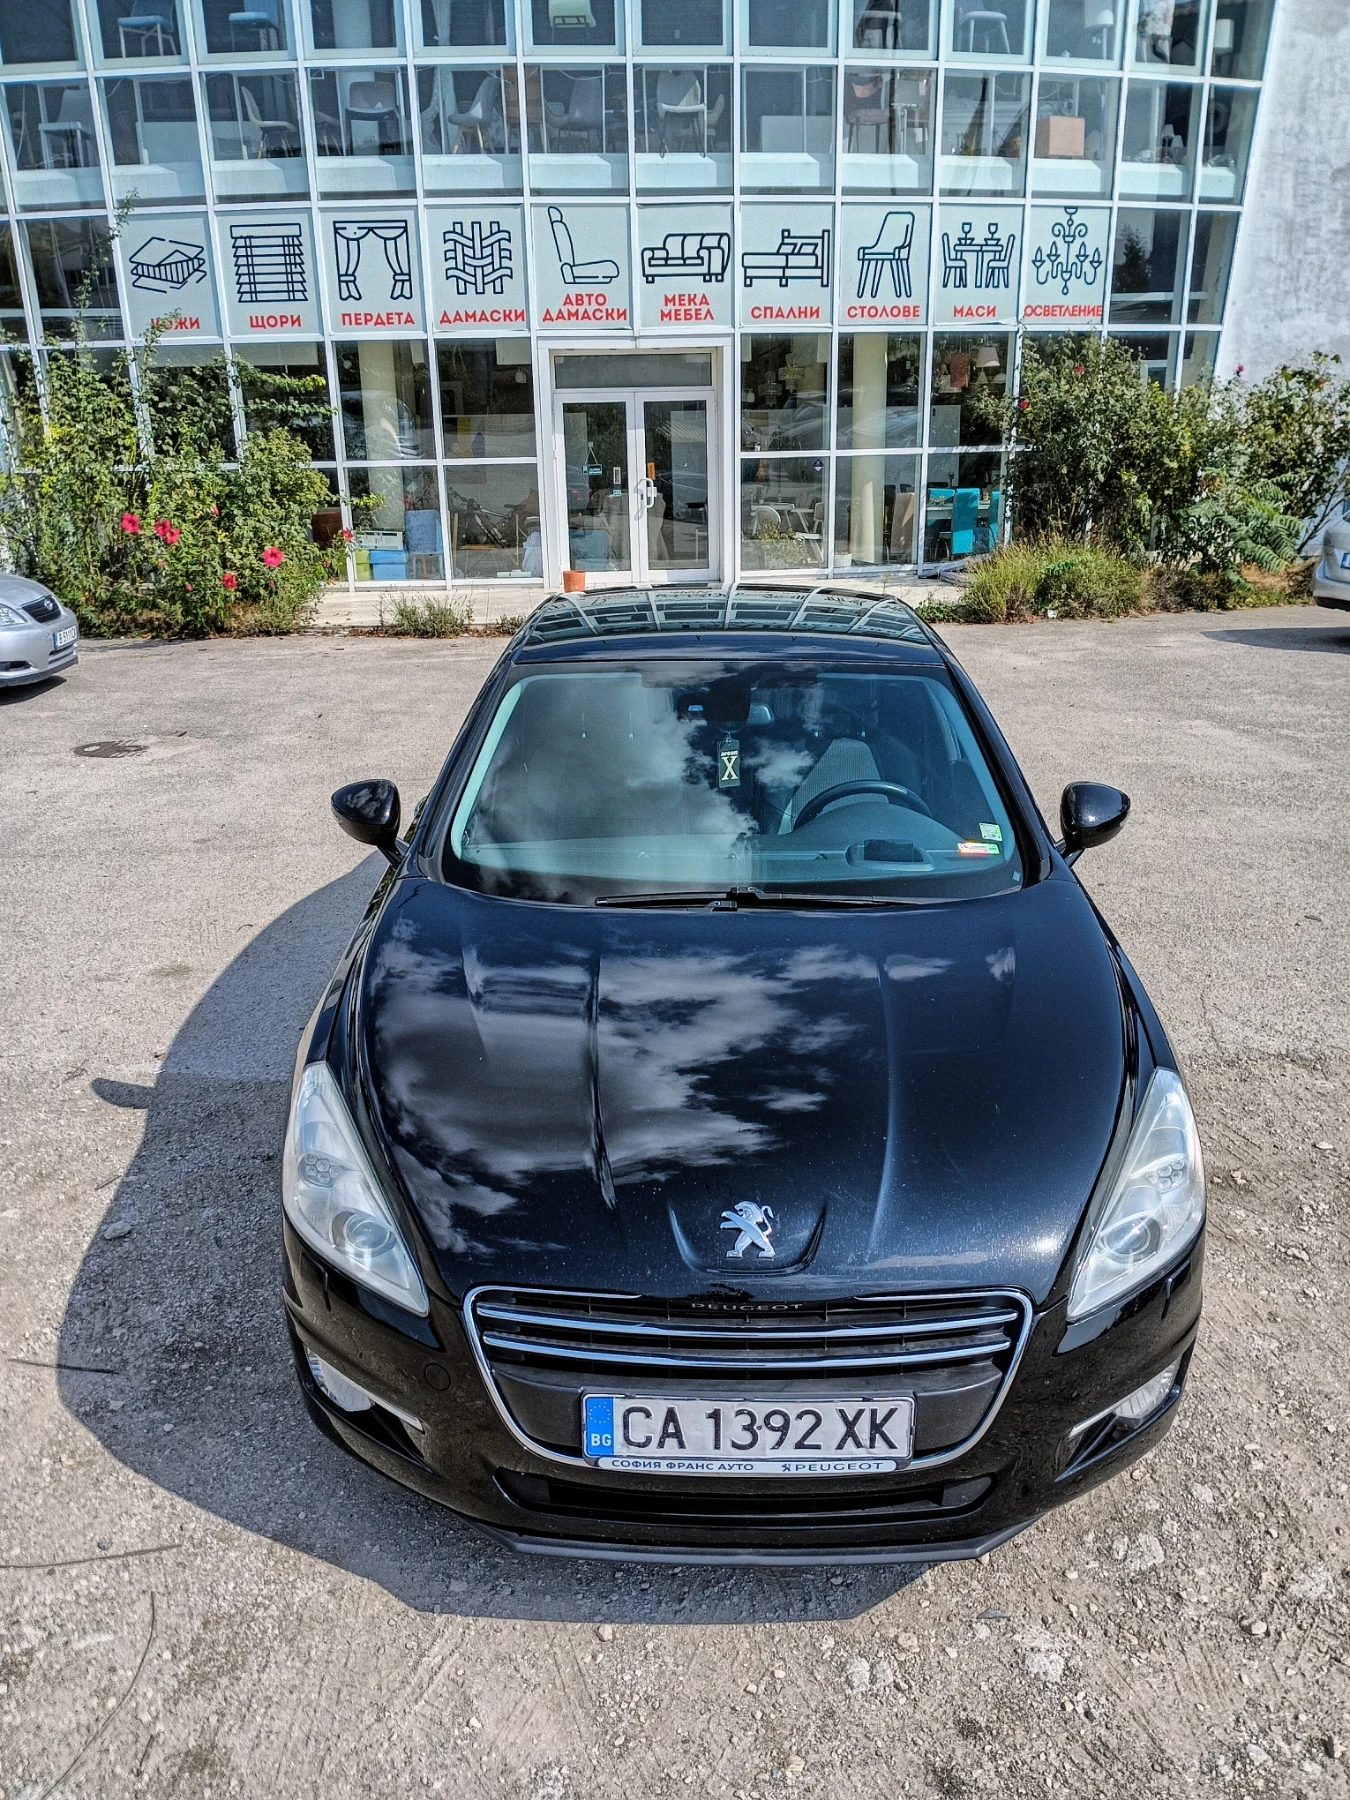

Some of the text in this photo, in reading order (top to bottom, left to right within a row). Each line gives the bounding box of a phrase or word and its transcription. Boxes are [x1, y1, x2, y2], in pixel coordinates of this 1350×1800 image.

[562, 293, 608, 307] АВТО
[663, 293, 710, 307] МЕКА
[439, 309, 526, 325] ДАМАСКИ
[542, 307, 628, 323] ДАМАСКИ
[659, 307, 715, 323] МЕБЕЛ
[750, 305, 821, 320] СПАЛНИ
[846, 304, 921, 319] СТОЛОВЕ
[953, 305, 997, 318] МАСИ
[1024, 304, 1104, 318] ОСВЕТЛЕНИЕ
[248, 314, 302, 329] ЩОРИ
[340, 311, 416, 327] ПЕРДЕТА
[721, 756, 739, 780] X
[691, 1303, 803, 1311] PEUGEOT
[622, 1406, 899, 1450] CA 1392 XK
[590, 1433, 612, 1447] BG
[611, 1459, 755, 1472] СОФИЯ ФРАНС АУТО
[794, 1461, 884, 1472] PEUGEOT
